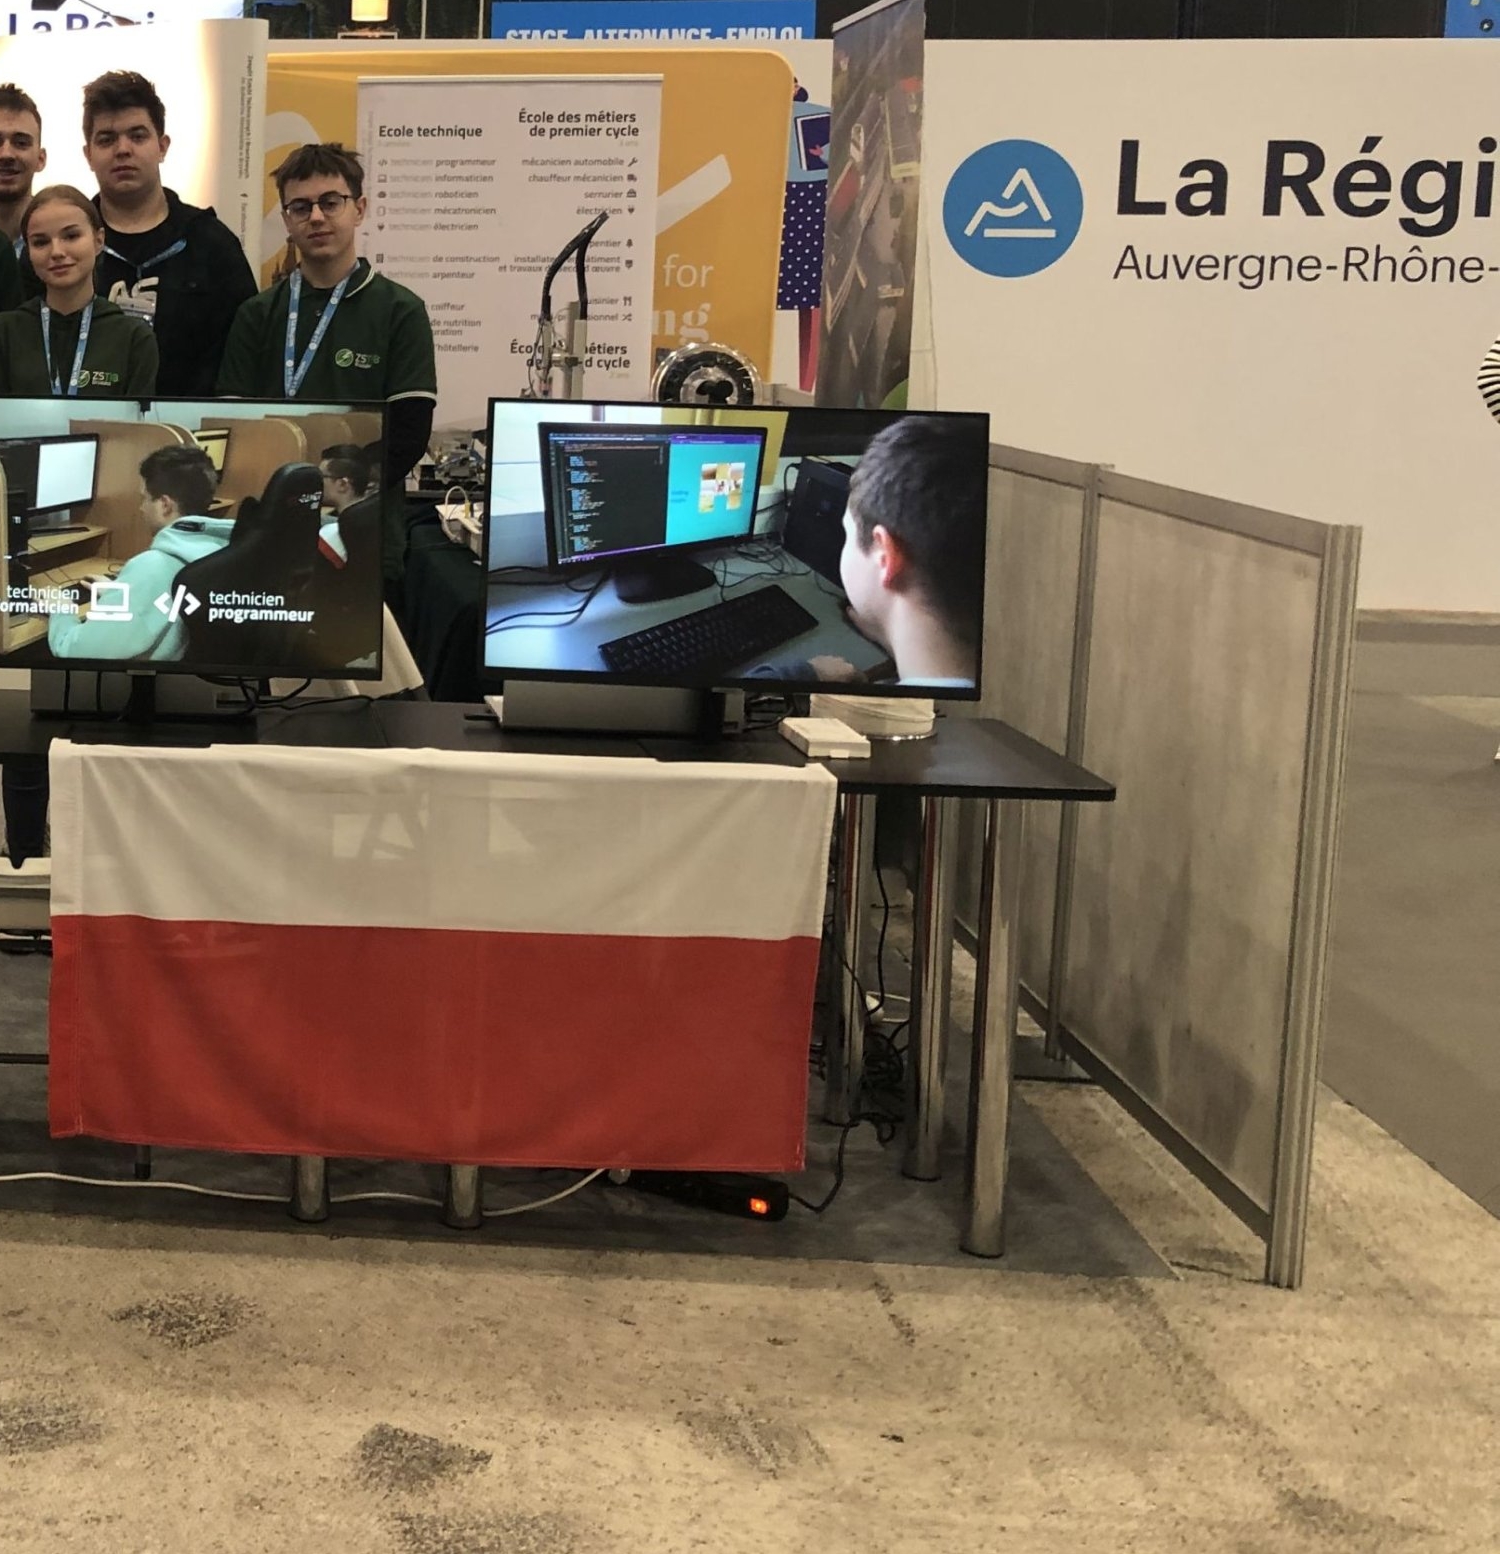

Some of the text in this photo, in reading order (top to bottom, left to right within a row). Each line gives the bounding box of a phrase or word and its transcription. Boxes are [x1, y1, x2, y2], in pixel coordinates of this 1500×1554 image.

[726, 26, 803, 40] EMPLOI
[519, 108, 637, 123] École des métiers
[378, 125, 483, 140] Ecole technique
[529, 125, 640, 140] de premier cycle
[435, 158, 496, 169] programmeur
[521, 157, 625, 166] mécanicien automobile
[435, 174, 494, 182] informaticien
[528, 173, 624, 182] chauffeur mécanicien
[1117, 135, 1498, 238] La Régi
[434, 190, 479, 198] roboticien
[584, 190, 623, 199] serrurier
[589, 240, 621, 248] pentier
[432, 255, 444, 263] de
[514, 255, 555, 263] installate
[585, 255, 621, 263] âtiment
[510, 265, 542, 273] travaux
[663, 253, 714, 288] for
[1112, 243, 1500, 291] Auvergne-Rhône-
[433, 328, 463, 336] uration
[597, 356, 631, 370] cycle
[7, 585, 80, 600] technicien
[209, 590, 285, 606] technicien
[208, 606, 315, 623] programmeur
